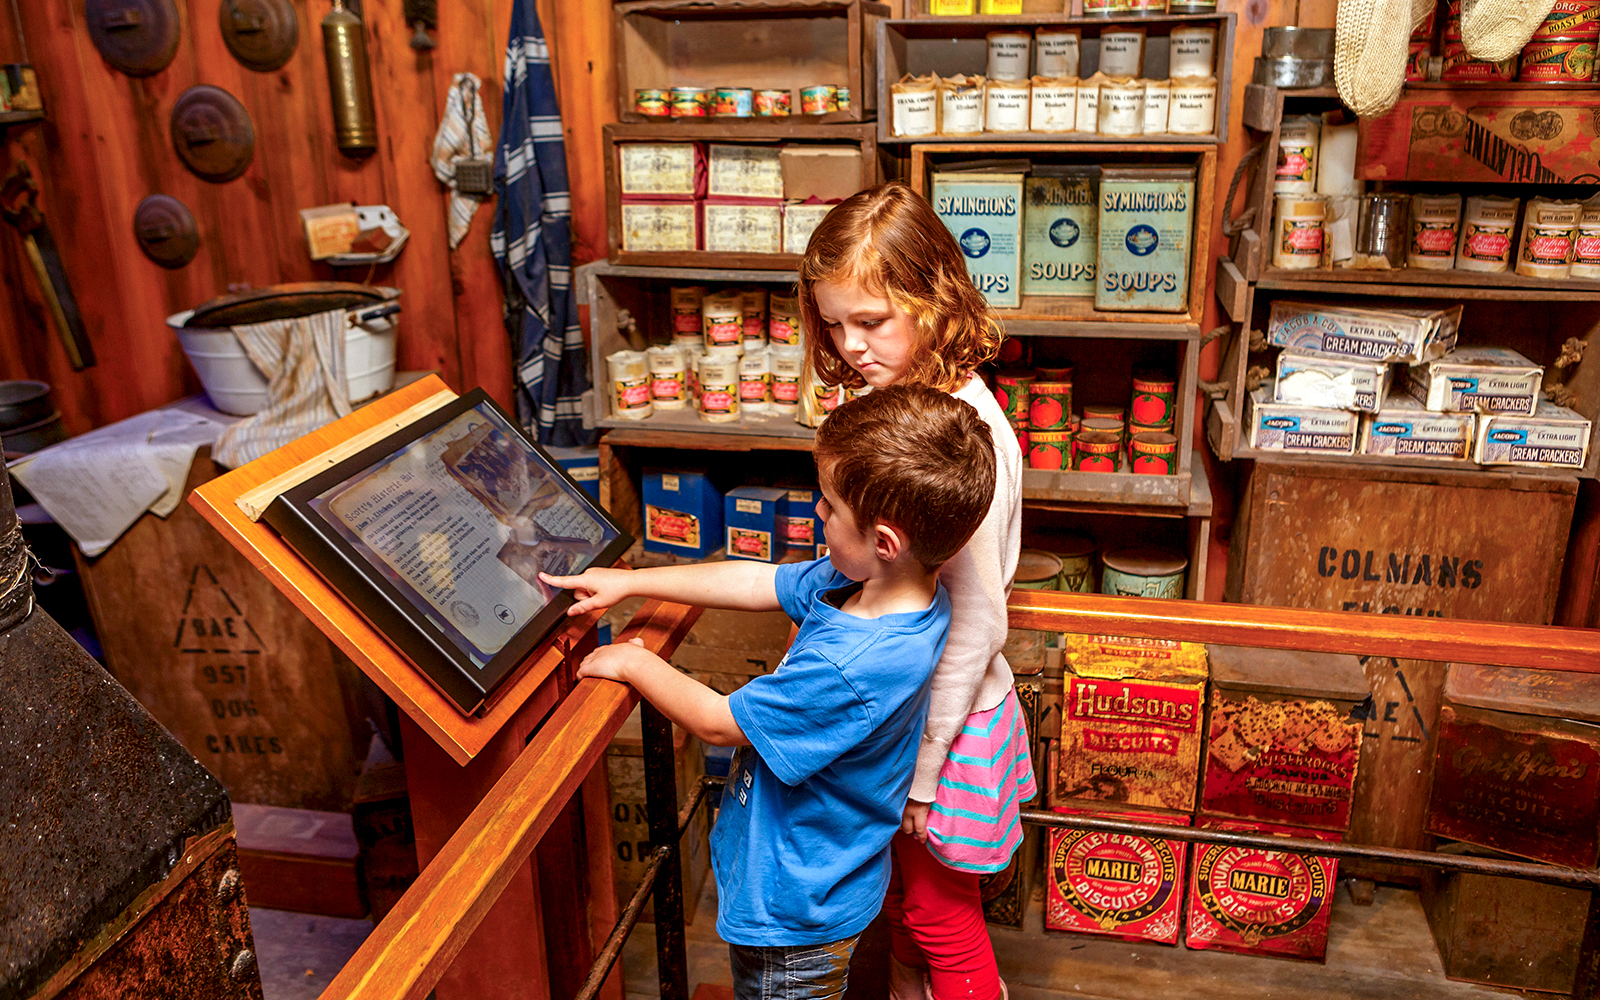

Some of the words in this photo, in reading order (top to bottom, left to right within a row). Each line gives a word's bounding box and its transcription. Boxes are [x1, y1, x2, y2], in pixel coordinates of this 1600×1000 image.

[1548, 17, 1577, 33] ROAST
[938, 194, 1016, 215] SYMINGTON'S
[1104, 191, 1186, 212] SYMINGTON'S
[1030, 262, 1096, 280] SOUPS
[973, 274, 1009, 292] UPS
[1105, 272, 1177, 292] SOUPS
[1350, 326, 1375, 336] EXTRA
[1326, 336, 1359, 354] CREAM
[1489, 381, 1508, 389] EXTRA
[1510, 381, 1528, 389] LIGHT
[1491, 396, 1530, 411] CRACKERS
[1286, 434, 1312, 447] CREAM
[1313, 435, 1351, 448] CRACKERS
[1398, 441, 1425, 453] CREAM
[1426, 441, 1464, 455] CRACKERS
[1512, 447, 1539, 461] CREAM
[1540, 449, 1580, 464] CRACKERS
[344, 500, 374, 522] Scott's
[370, 479, 403, 504] Historic
[400, 471, 415, 483] Hut
[1317, 546, 1485, 589] COLMANS
[203, 665, 247, 684] 957
[1074, 683, 1193, 721] Hudsons
[206, 735, 282, 755] CAKES
[1089, 734, 1174, 751] BISCUITS
[1091, 763, 1138, 778] FLOUR
[1055, 829, 1085, 868] SUPERIO
[1150, 837, 1174, 882] ISCUITS
[1069, 832, 1108, 876] HUNTLEY
[1110, 834, 1121, 844] &
[1122, 835, 1159, 886] PALMERS
[1087, 859, 1141, 882] MARIE
[1214, 847, 1252, 889] HUNTLE
[1232, 871, 1288, 896] MARIE
[1076, 881, 1148, 909] BISCUITS
[1220, 894, 1295, 922] BISCUITS
